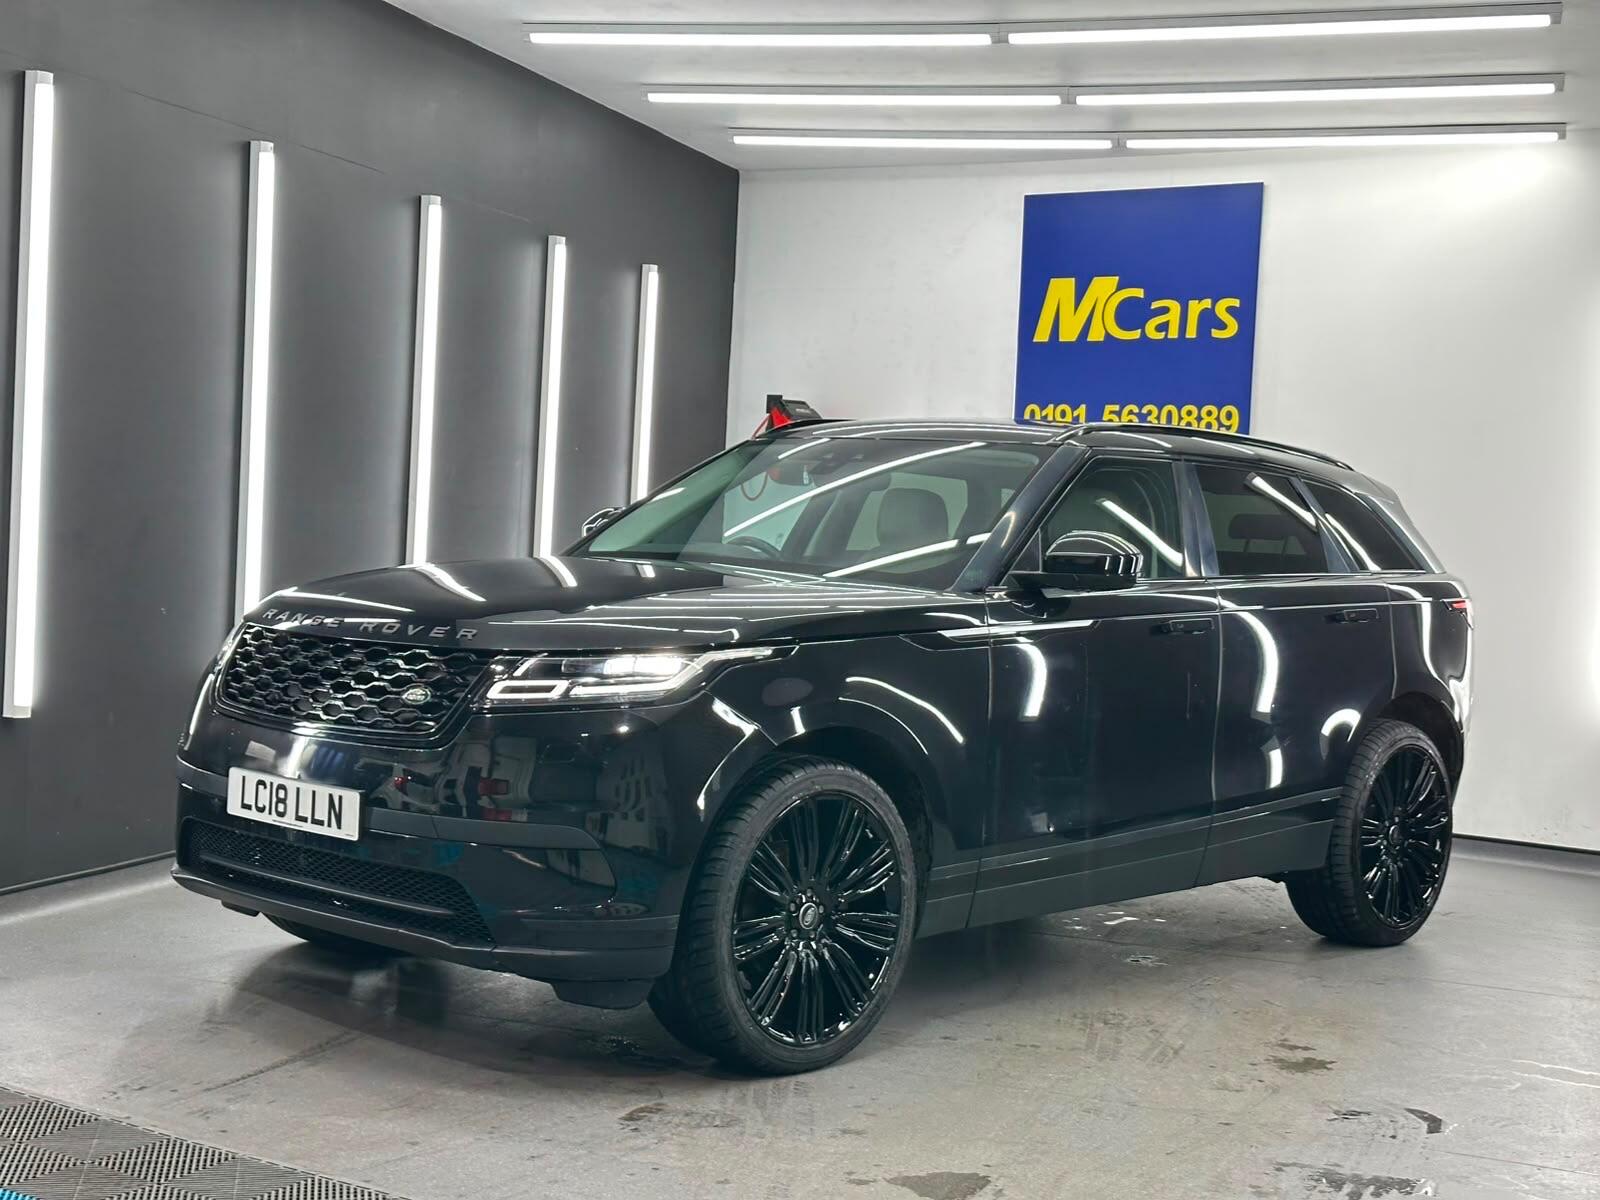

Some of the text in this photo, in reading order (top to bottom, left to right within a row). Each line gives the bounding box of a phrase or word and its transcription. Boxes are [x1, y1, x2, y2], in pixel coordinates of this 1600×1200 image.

[1024, 404, 1239, 433] 0191 5630889
[262, 608, 478, 640] RANGE ROVER
[240, 775, 343, 830] LC18 LLN
